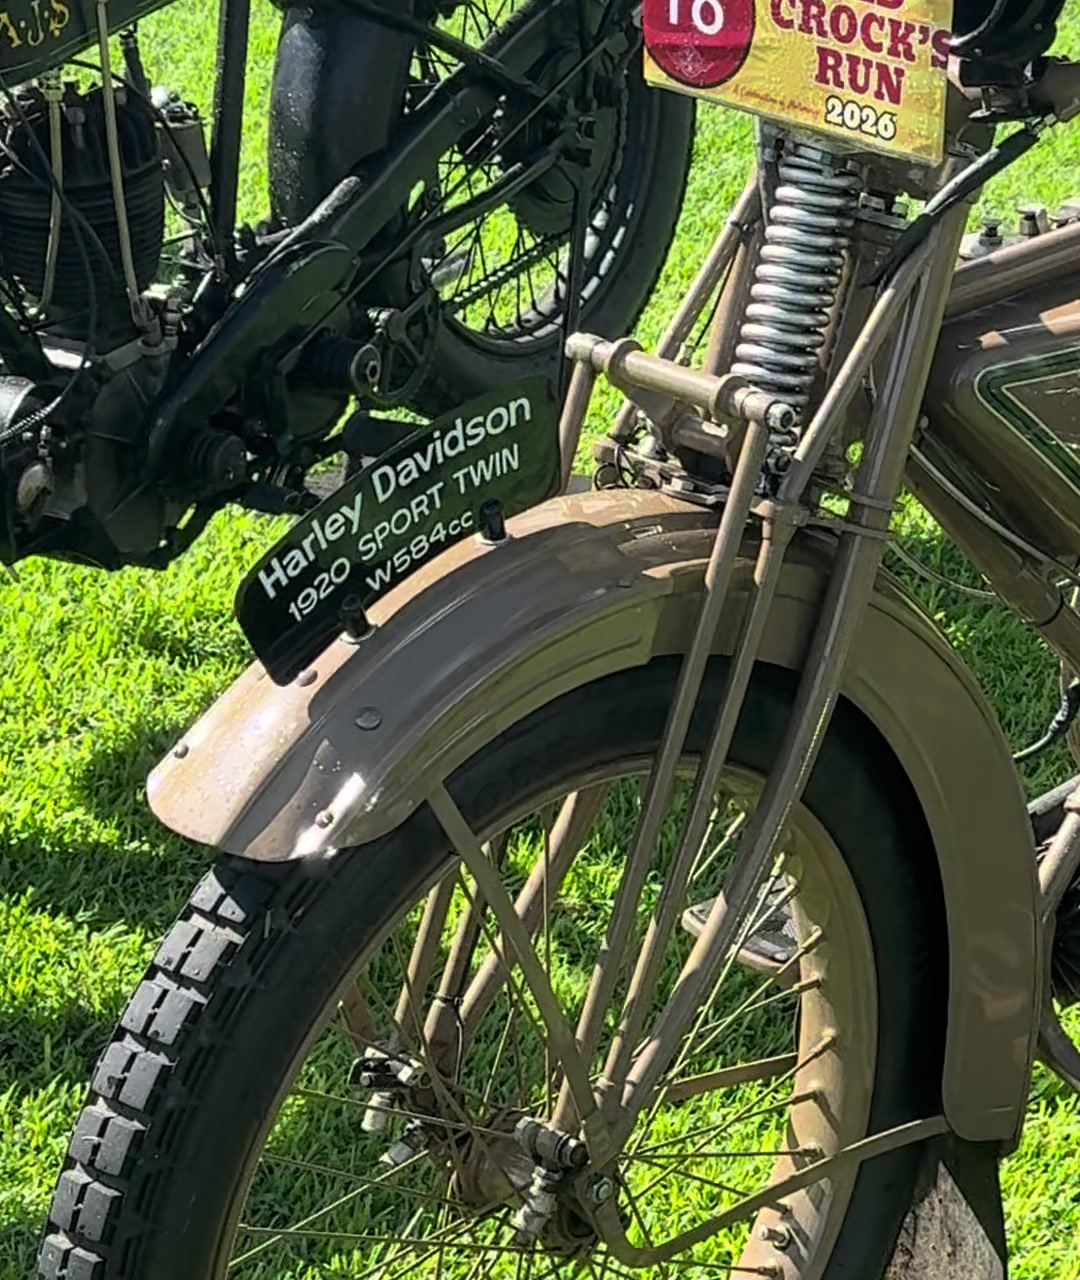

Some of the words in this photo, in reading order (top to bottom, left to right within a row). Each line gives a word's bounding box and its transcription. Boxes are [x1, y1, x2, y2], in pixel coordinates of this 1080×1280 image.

[814, 45, 906, 106] RUN
[824, 94, 898, 142] 2026
[257, 493, 363, 600] Harley
[371, 396, 532, 504] Davidson
[288, 557, 351, 622] 1920
[358, 482, 445, 562] SPORT
[452, 443, 520, 495] TWIN
[365, 511, 474, 592] W584cc
